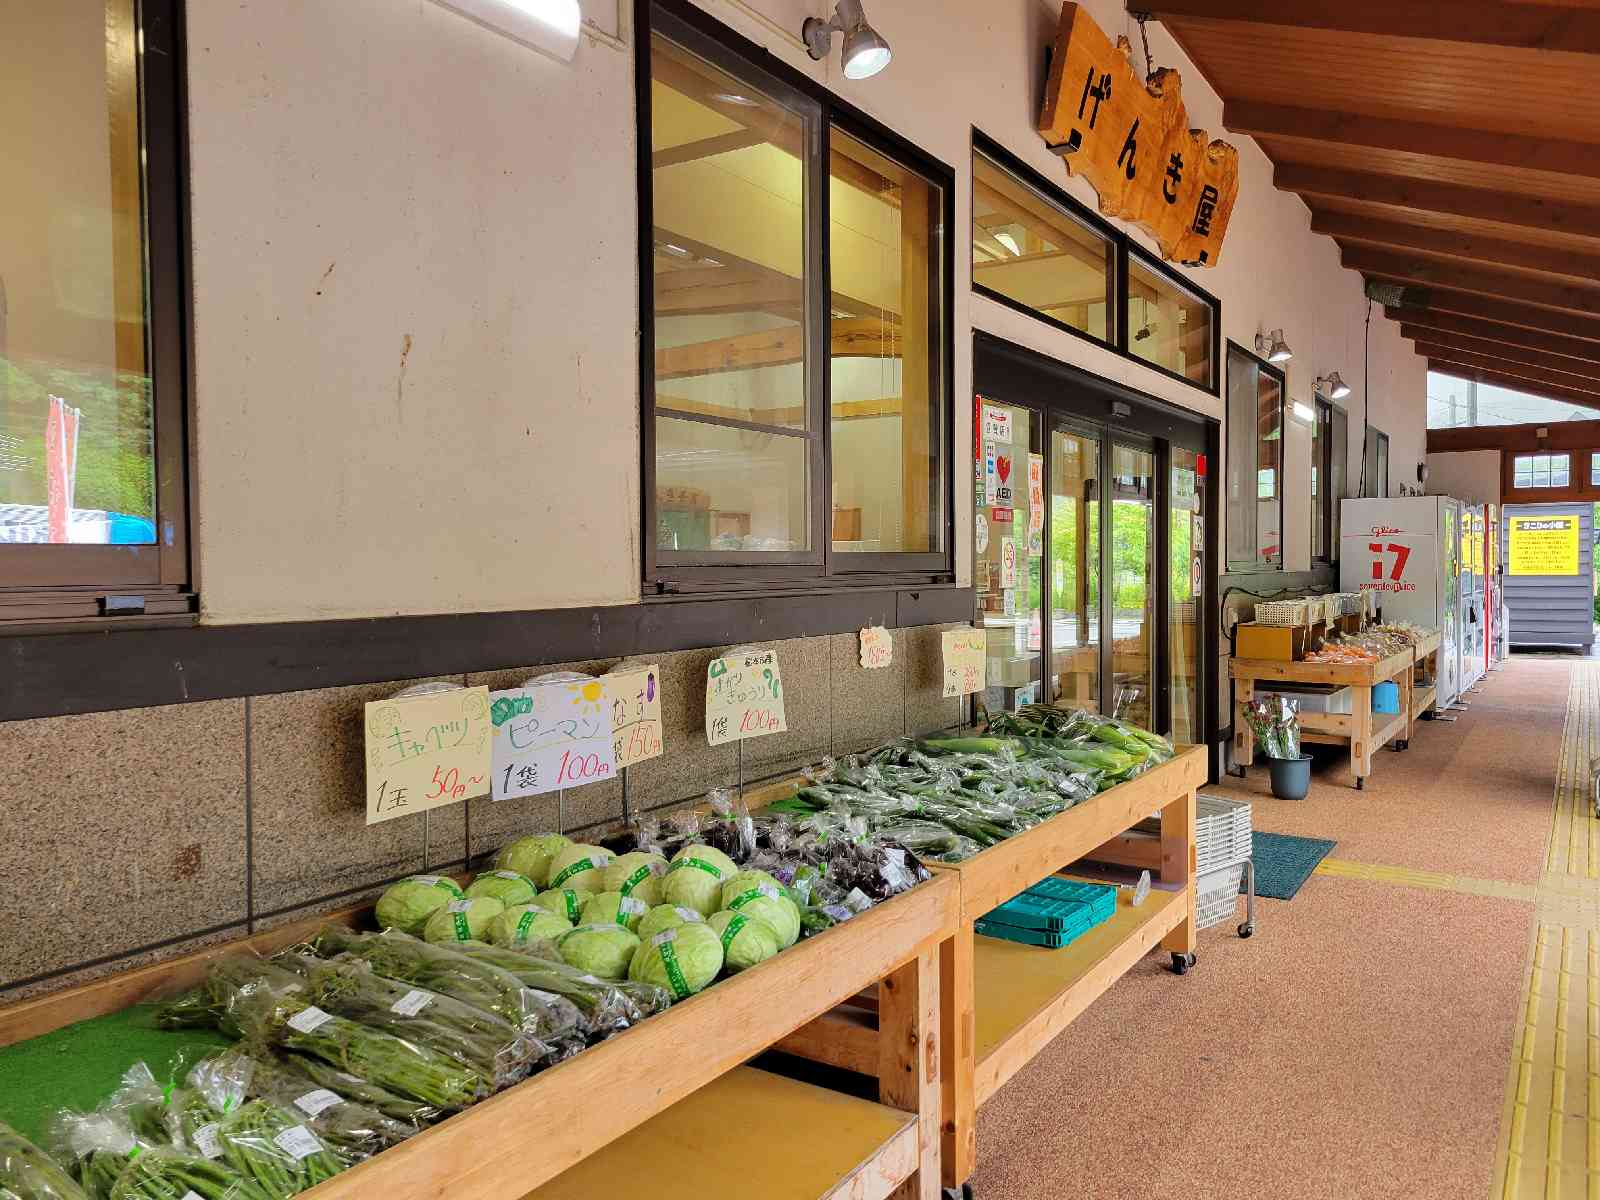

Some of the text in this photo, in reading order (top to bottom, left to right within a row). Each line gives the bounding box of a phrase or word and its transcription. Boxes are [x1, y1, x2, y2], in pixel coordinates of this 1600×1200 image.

[996, 487, 1012, 499] AED
[613, 688, 648, 726] なす
[386, 717, 468, 758] キャベツ
[509, 718, 601, 749] ピーマン
[503, 749, 609, 794] 1袋 100円
